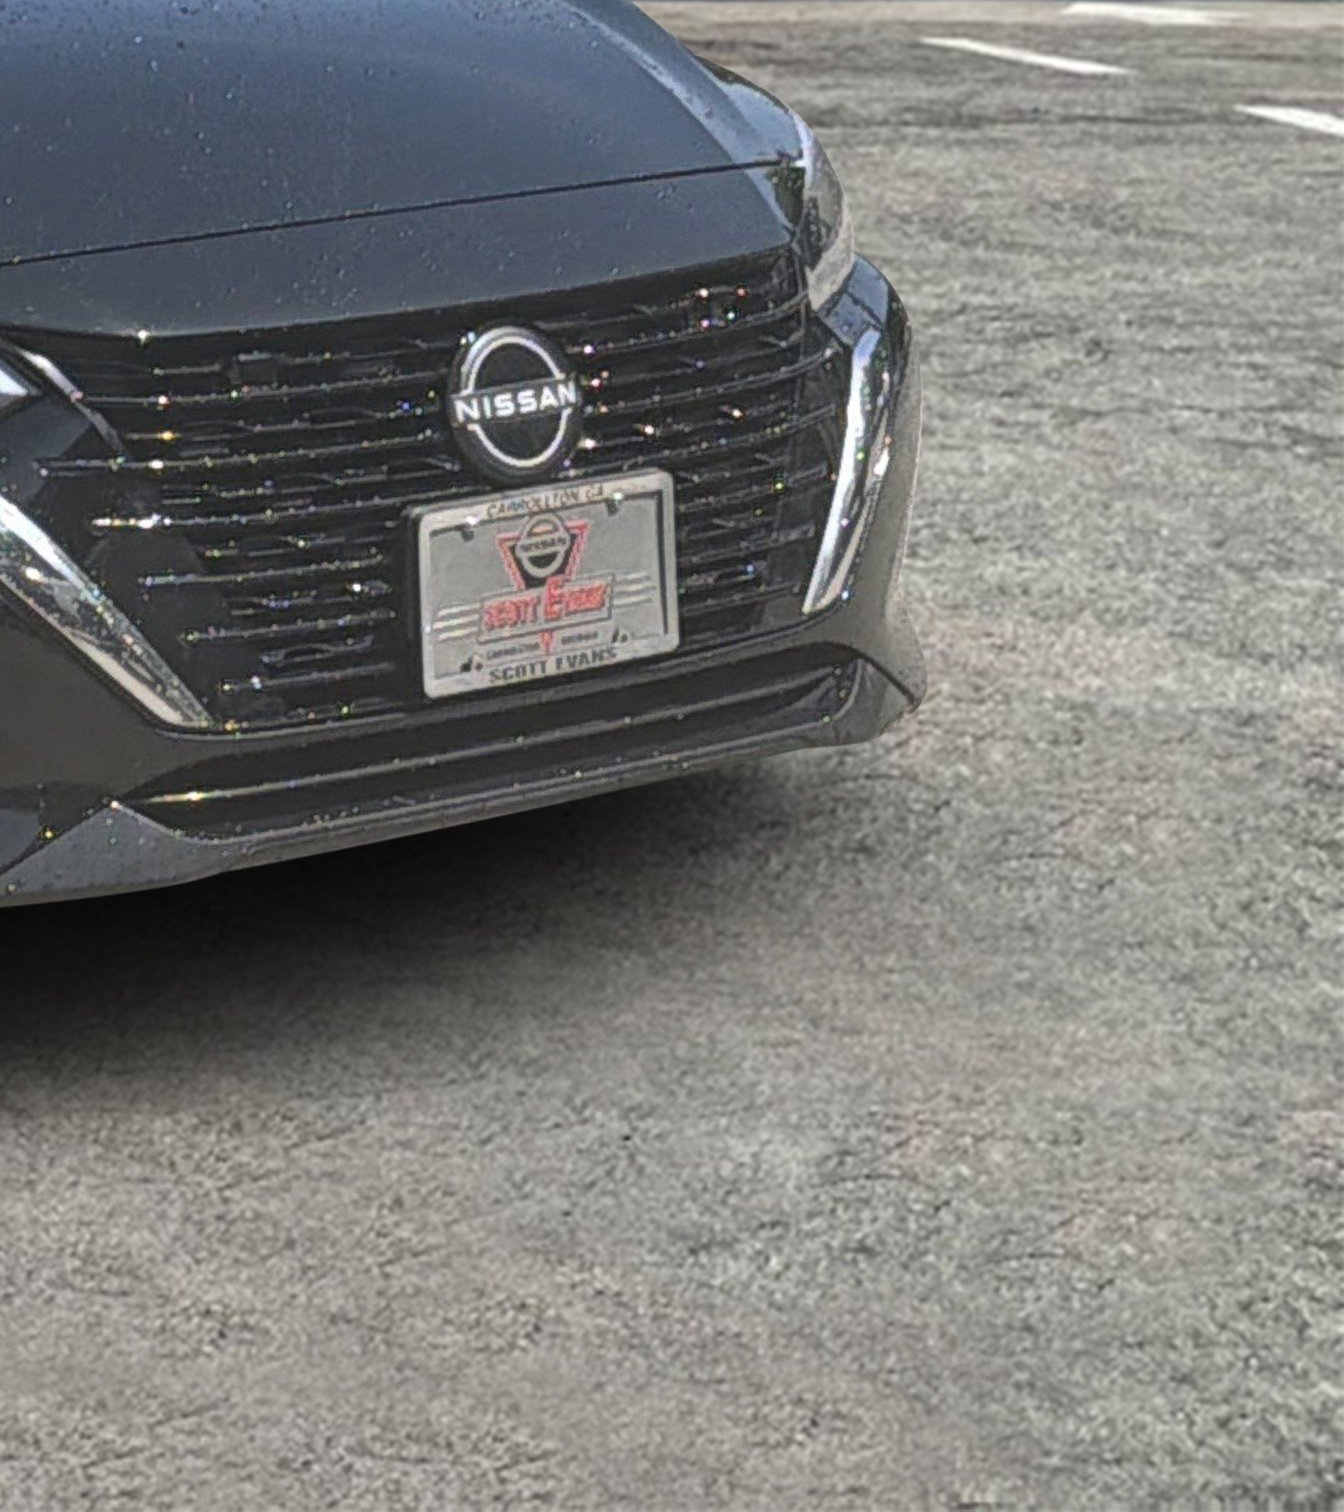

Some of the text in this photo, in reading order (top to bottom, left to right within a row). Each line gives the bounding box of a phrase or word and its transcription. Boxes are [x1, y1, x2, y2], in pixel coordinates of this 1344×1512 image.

[453, 380, 578, 424] NISSAN
[489, 660, 548, 683] SCOTT
[555, 645, 617, 670] EVANS
